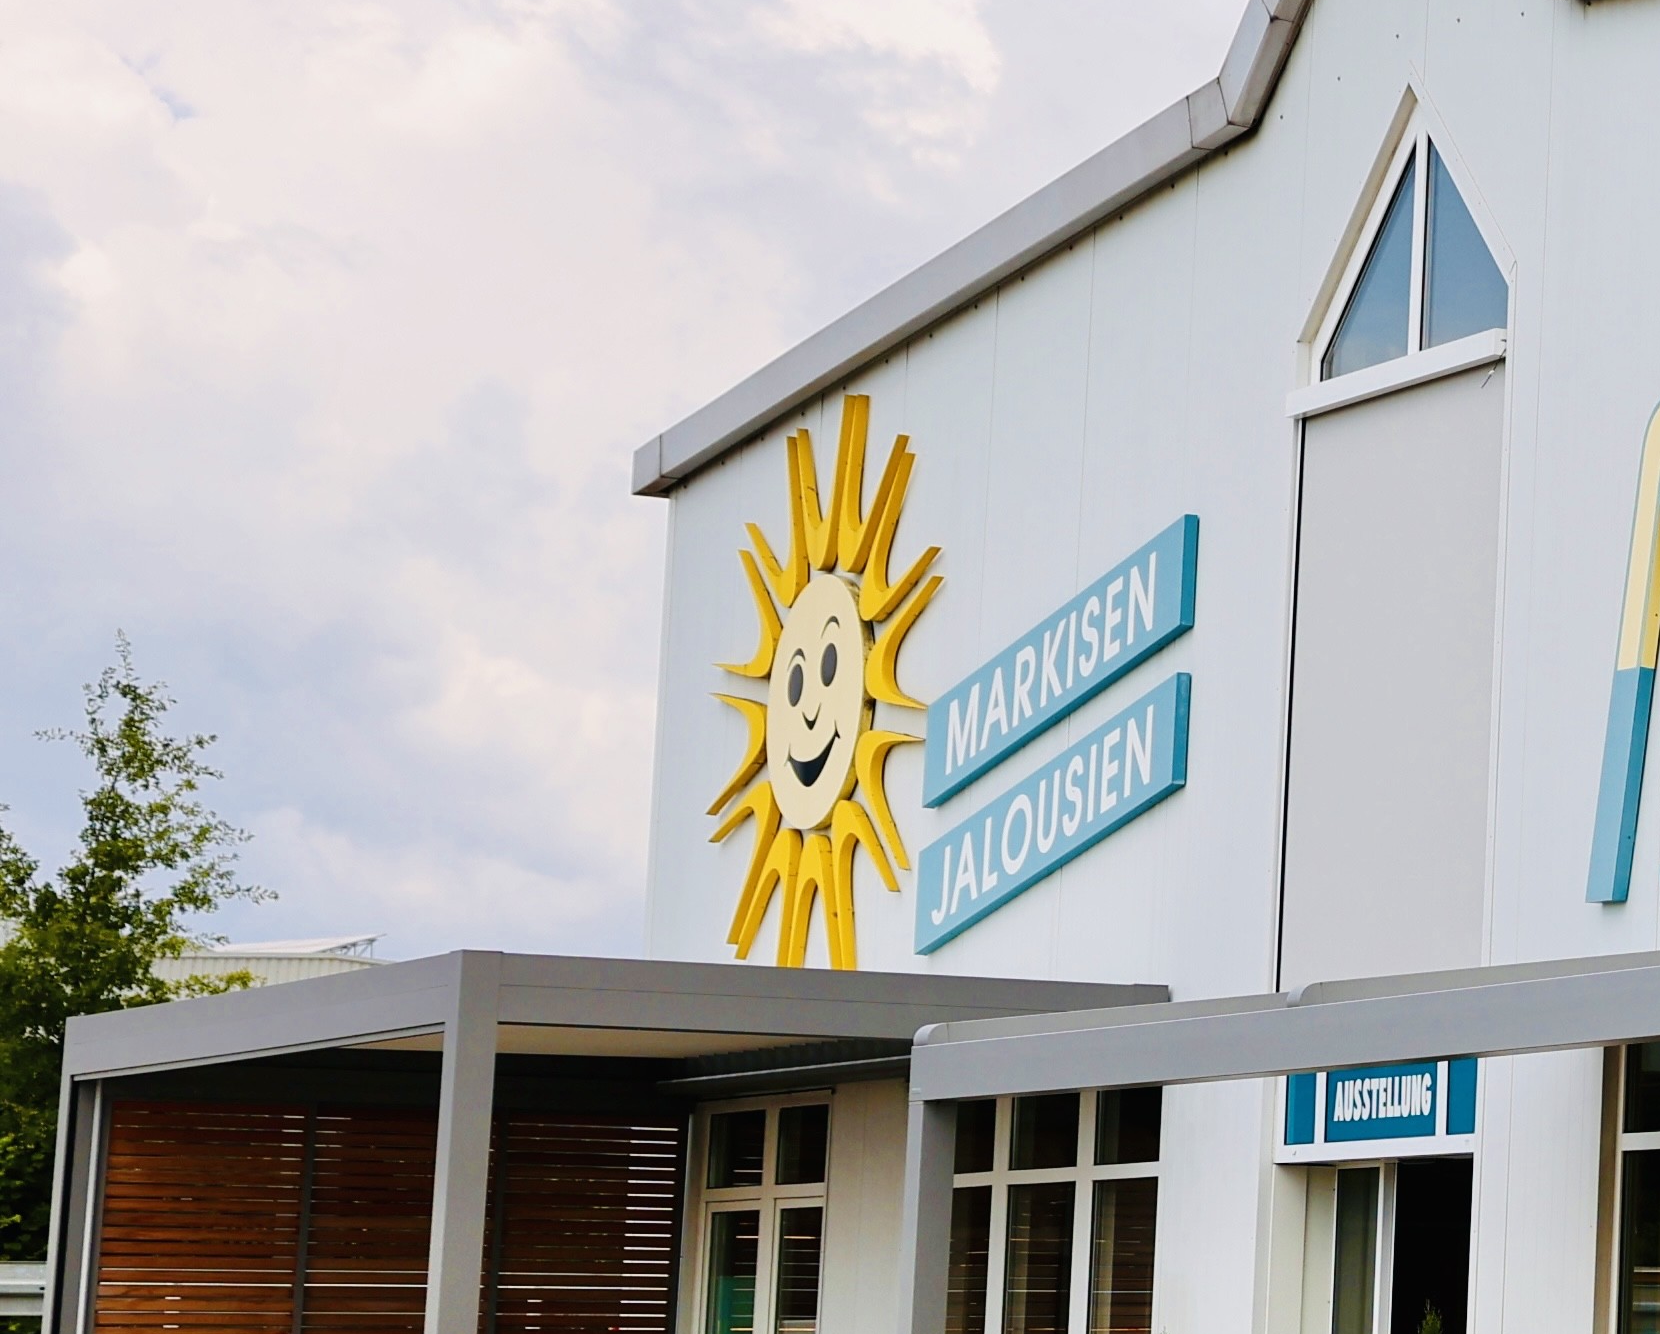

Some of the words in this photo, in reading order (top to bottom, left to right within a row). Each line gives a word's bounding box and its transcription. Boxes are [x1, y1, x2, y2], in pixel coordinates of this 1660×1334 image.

[945, 551, 1158, 776] MARKISEN
[930, 704, 1155, 926] JALOUSIEN
[1333, 1072, 1433, 1122] AUSSTELLUNG
